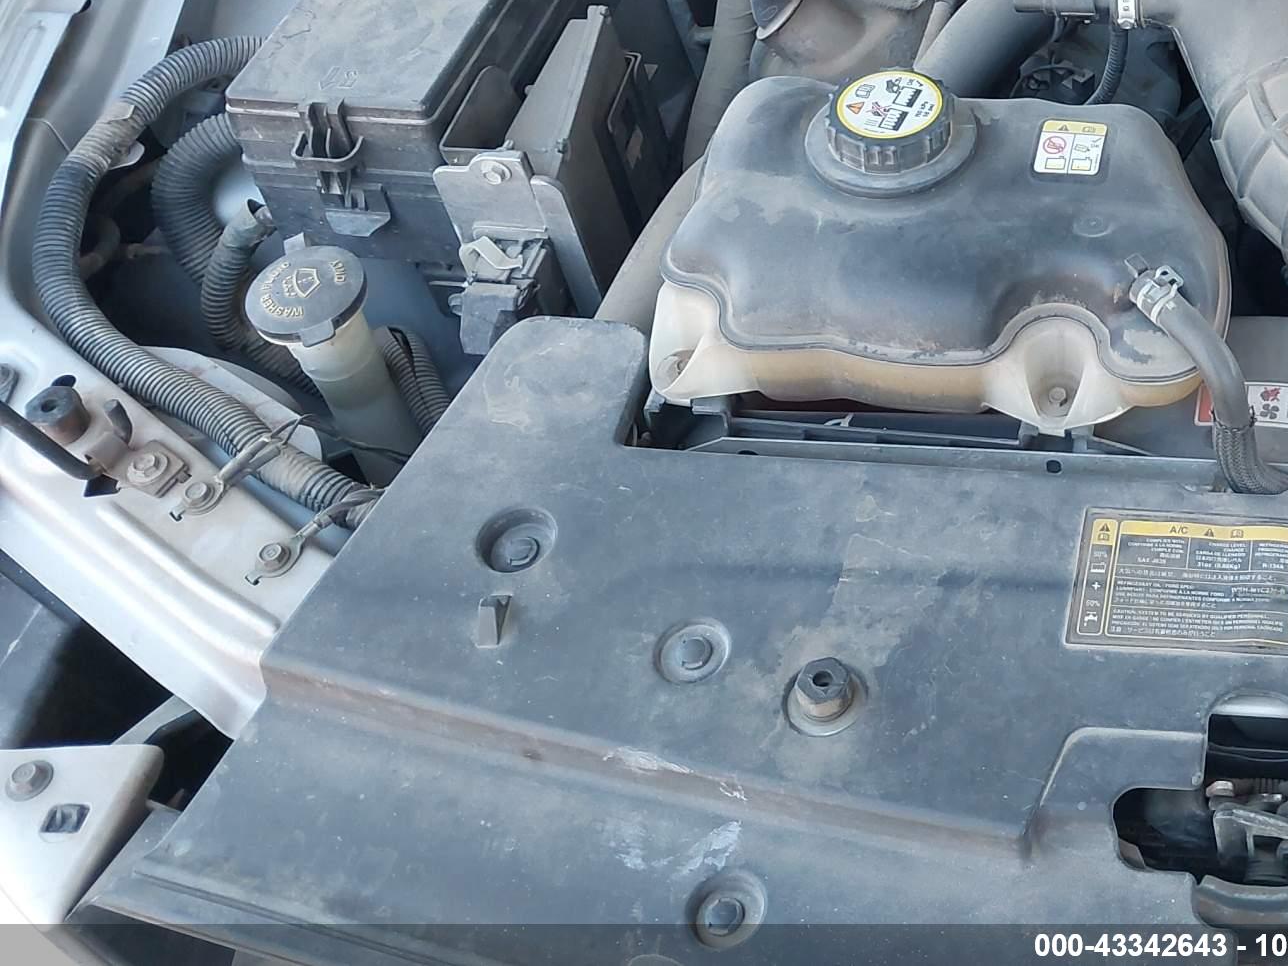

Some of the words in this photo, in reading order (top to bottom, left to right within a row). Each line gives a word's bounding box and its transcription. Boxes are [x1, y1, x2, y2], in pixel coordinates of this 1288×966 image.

[260, 262, 291, 291] FLUID
[329, 259, 347, 283] ONLY
[260, 294, 304, 318] WASHER
[1169, 526, 1188, 535] A/C
